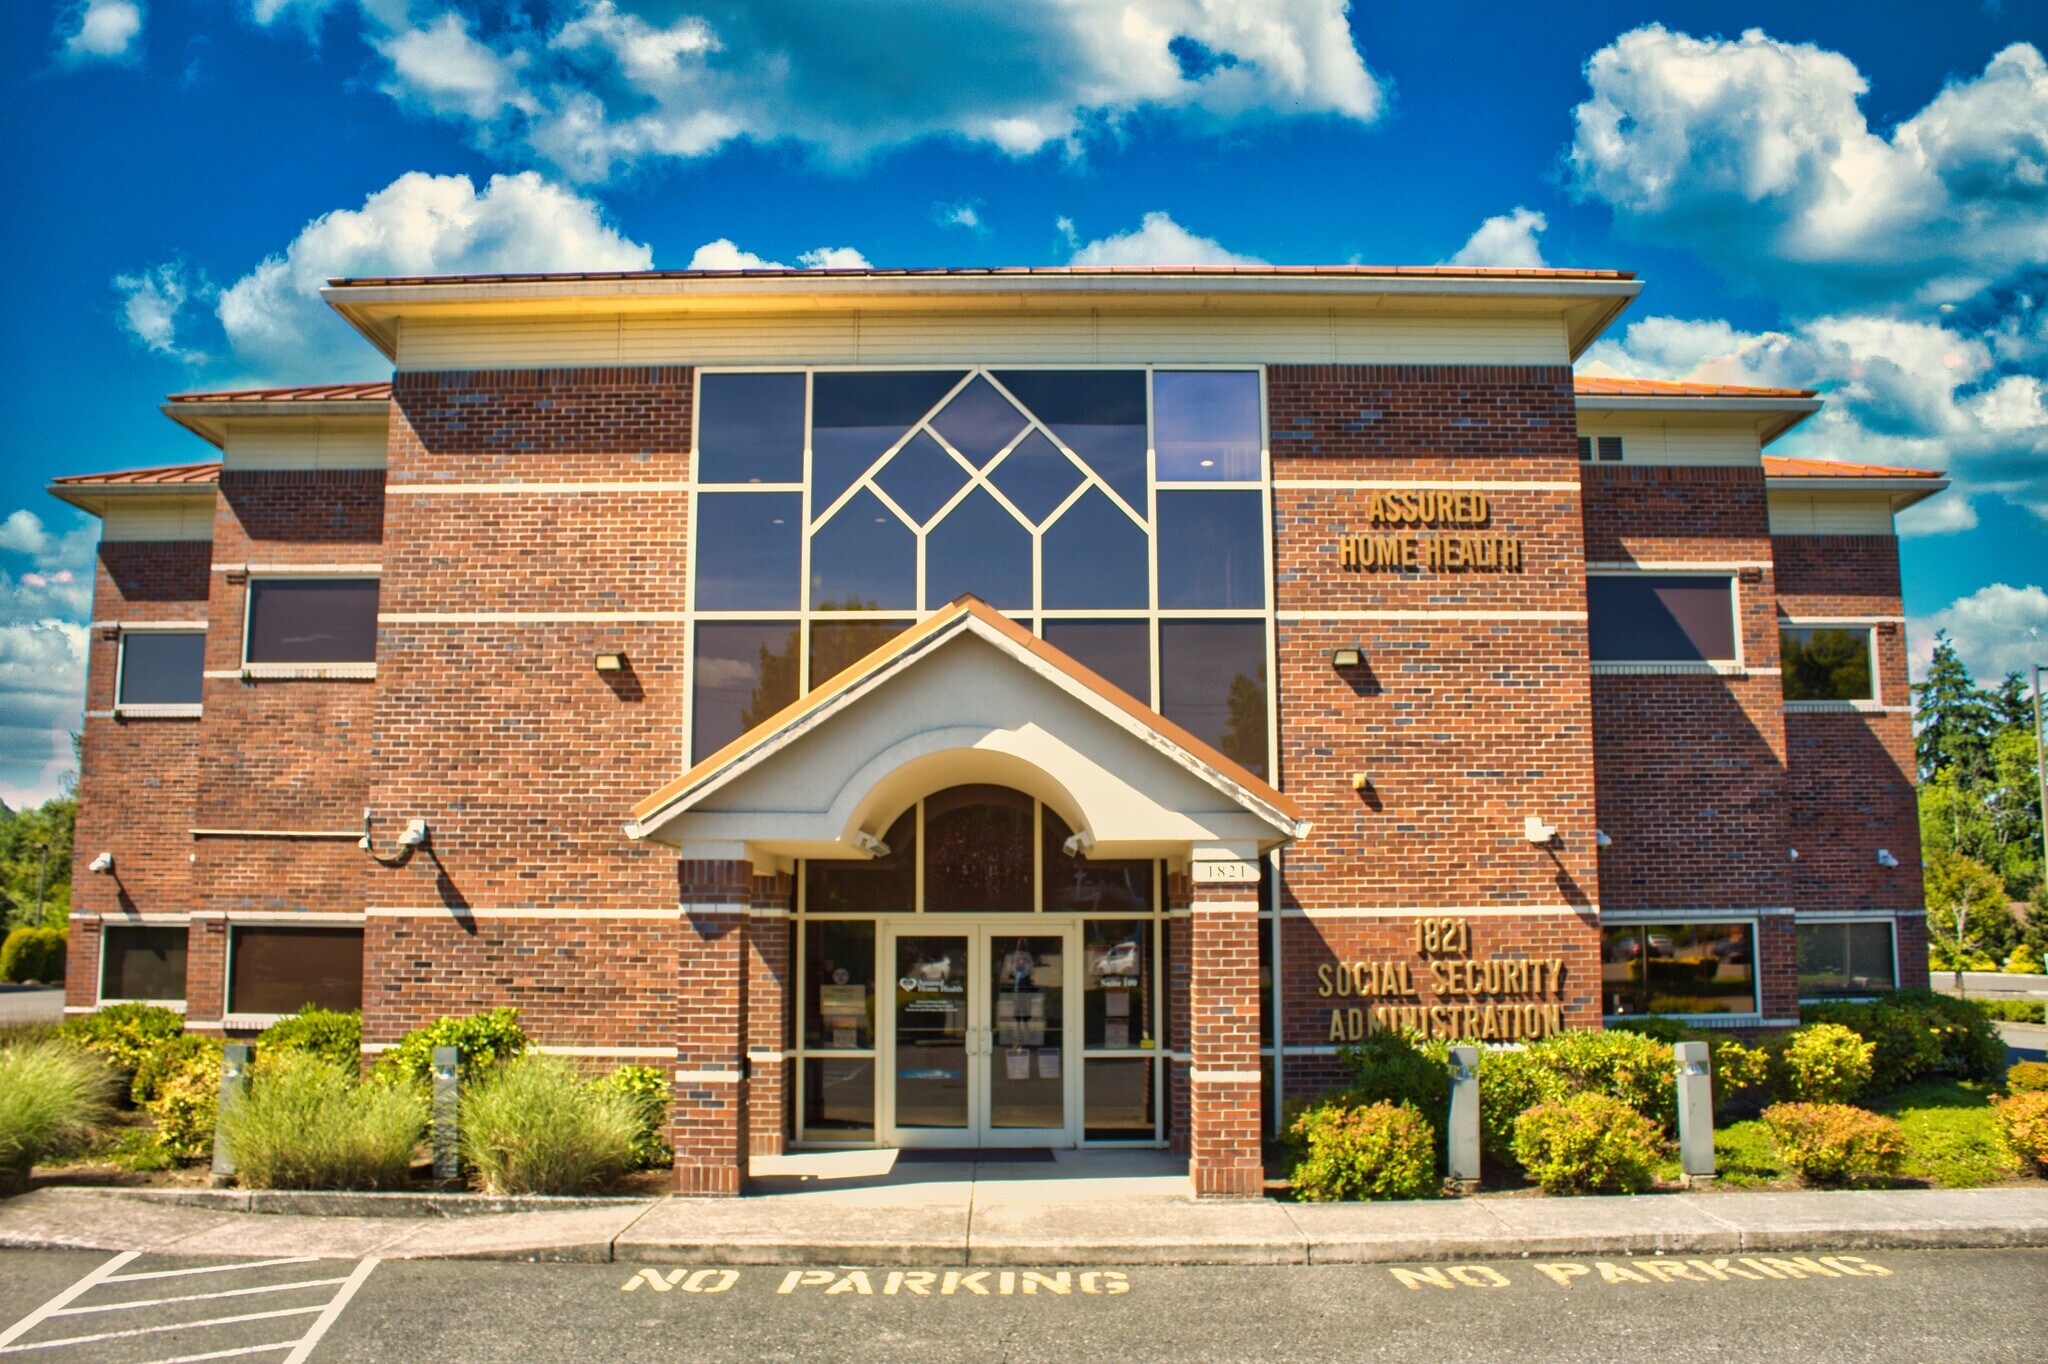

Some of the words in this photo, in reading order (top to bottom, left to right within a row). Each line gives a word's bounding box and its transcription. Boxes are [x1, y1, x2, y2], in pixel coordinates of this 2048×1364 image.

[1368, 490, 1489, 523] ASSURED
[1340, 534, 1416, 566] HOME
[1425, 534, 1519, 567] HEALTH
[1208, 865, 1245, 878] 1821
[1415, 918, 1469, 953] 1821
[1317, 961, 1416, 998] SOCIAL
[1430, 958, 1564, 996] SECURITY
[1329, 1004, 1563, 1042] ADMINISTRATION
[620, 1268, 741, 1293] NO
[776, 1270, 1131, 1296] PARKING
[1388, 1265, 1512, 1290] NO
[1534, 1256, 1896, 1290] PARKING
